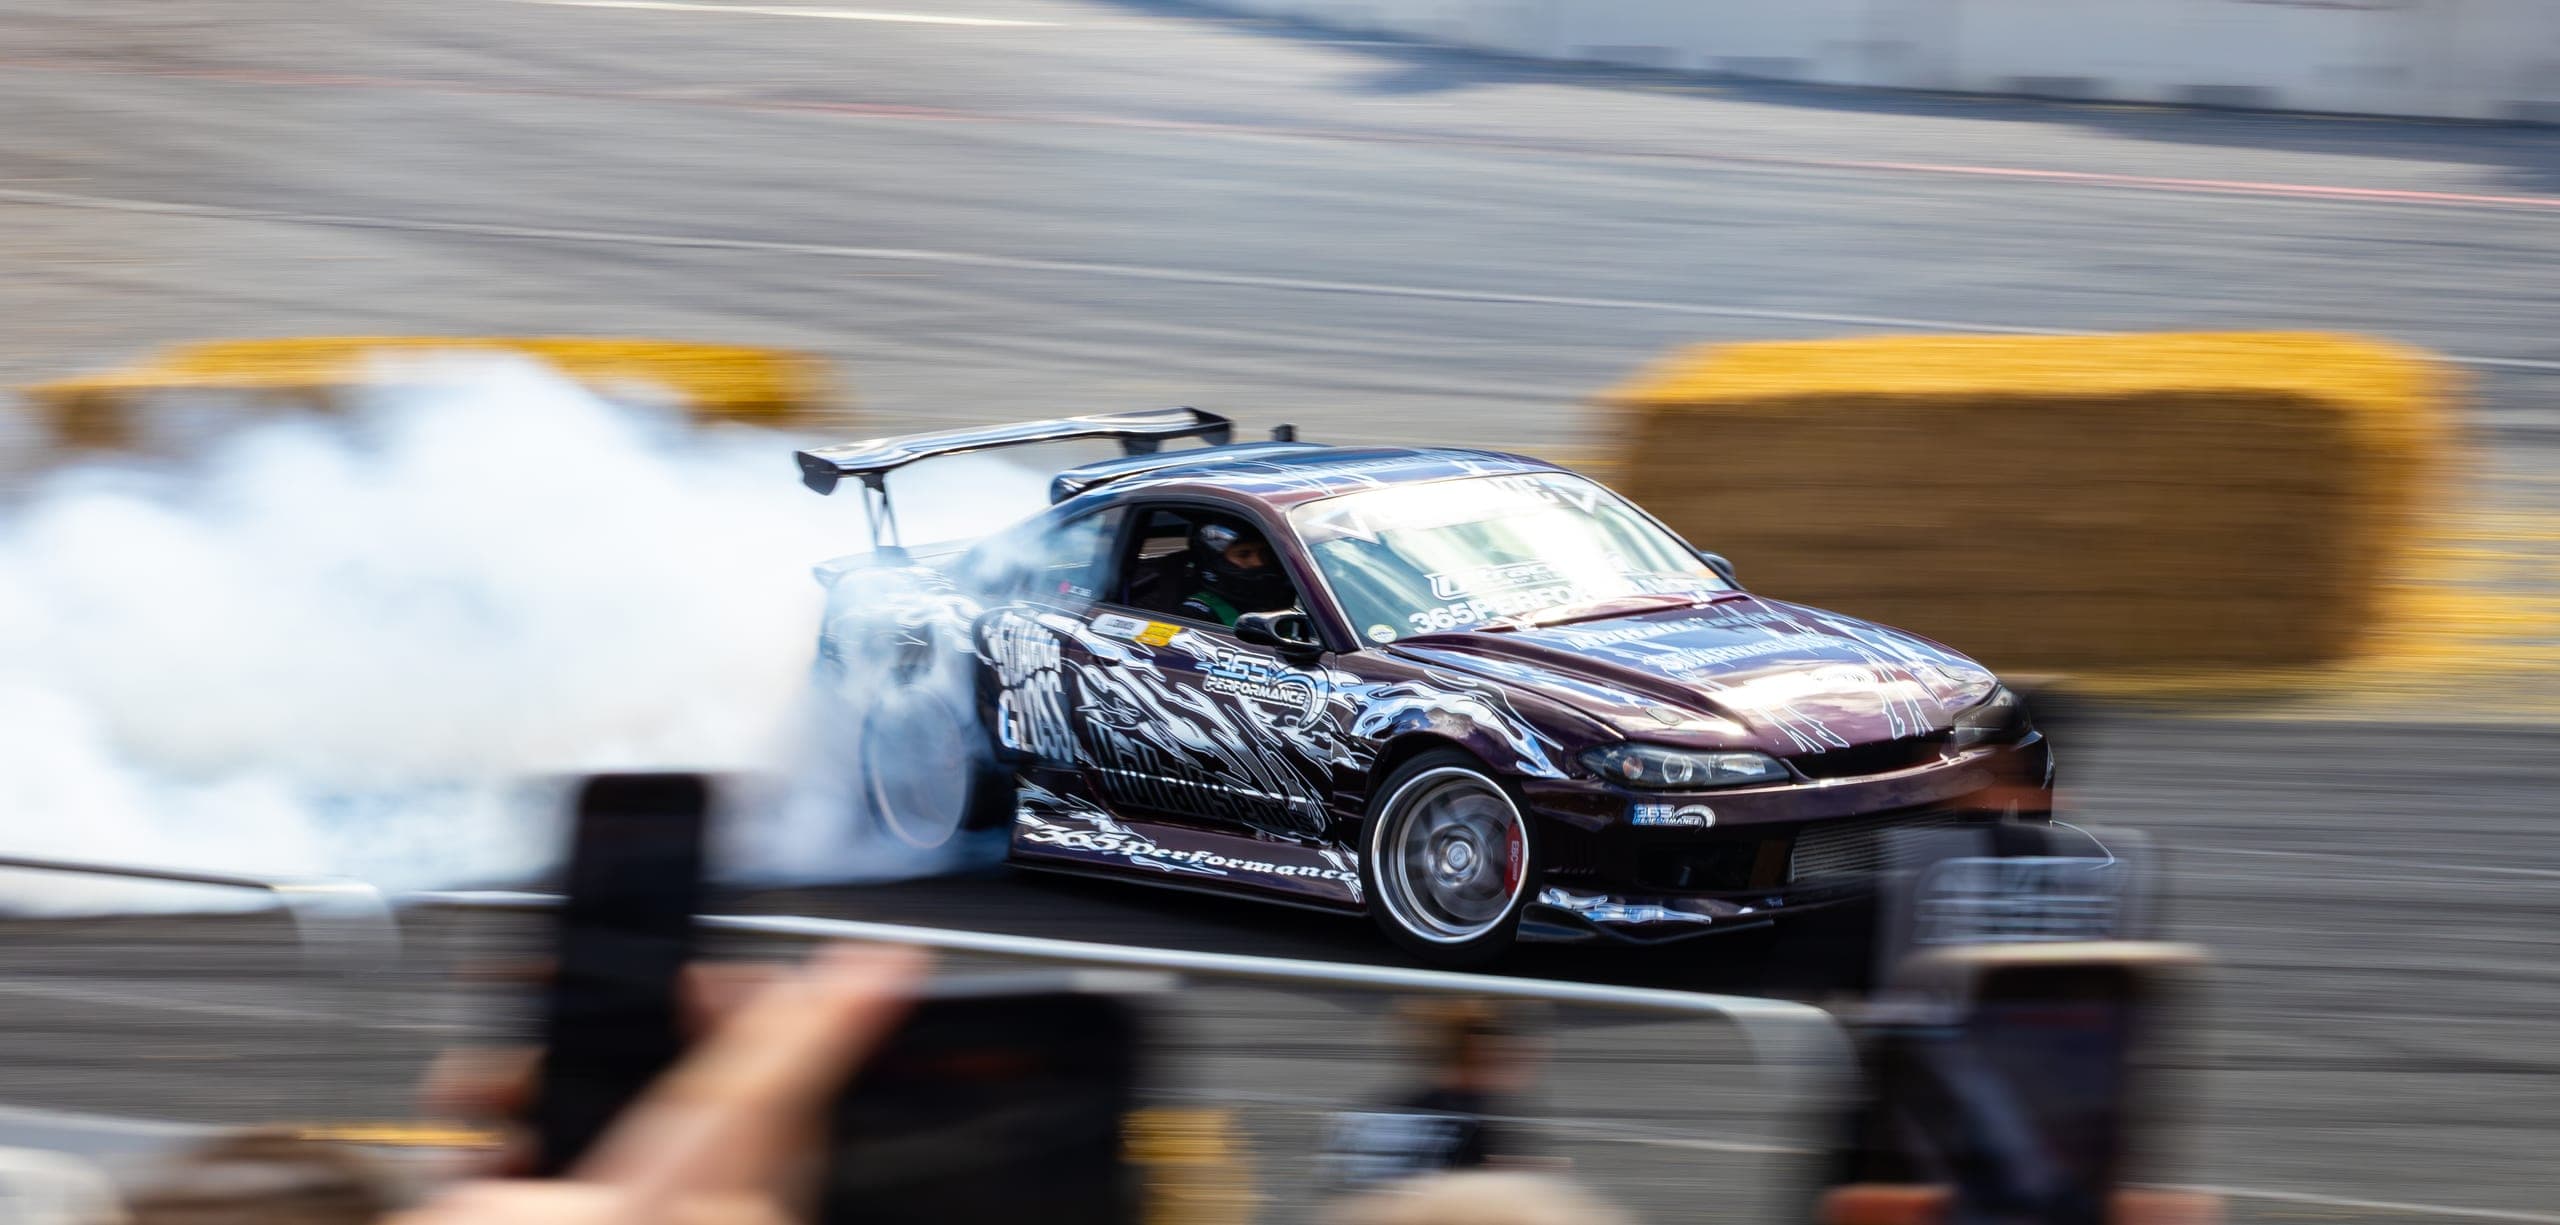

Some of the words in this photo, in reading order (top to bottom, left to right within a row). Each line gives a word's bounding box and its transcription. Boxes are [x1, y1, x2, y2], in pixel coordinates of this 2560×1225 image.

[1211, 648, 1273, 684] 365
[1205, 675, 1307, 705] PERFORMANCE
[998, 669, 1075, 764] GLOSS
[1633, 803, 1675, 818] 365
